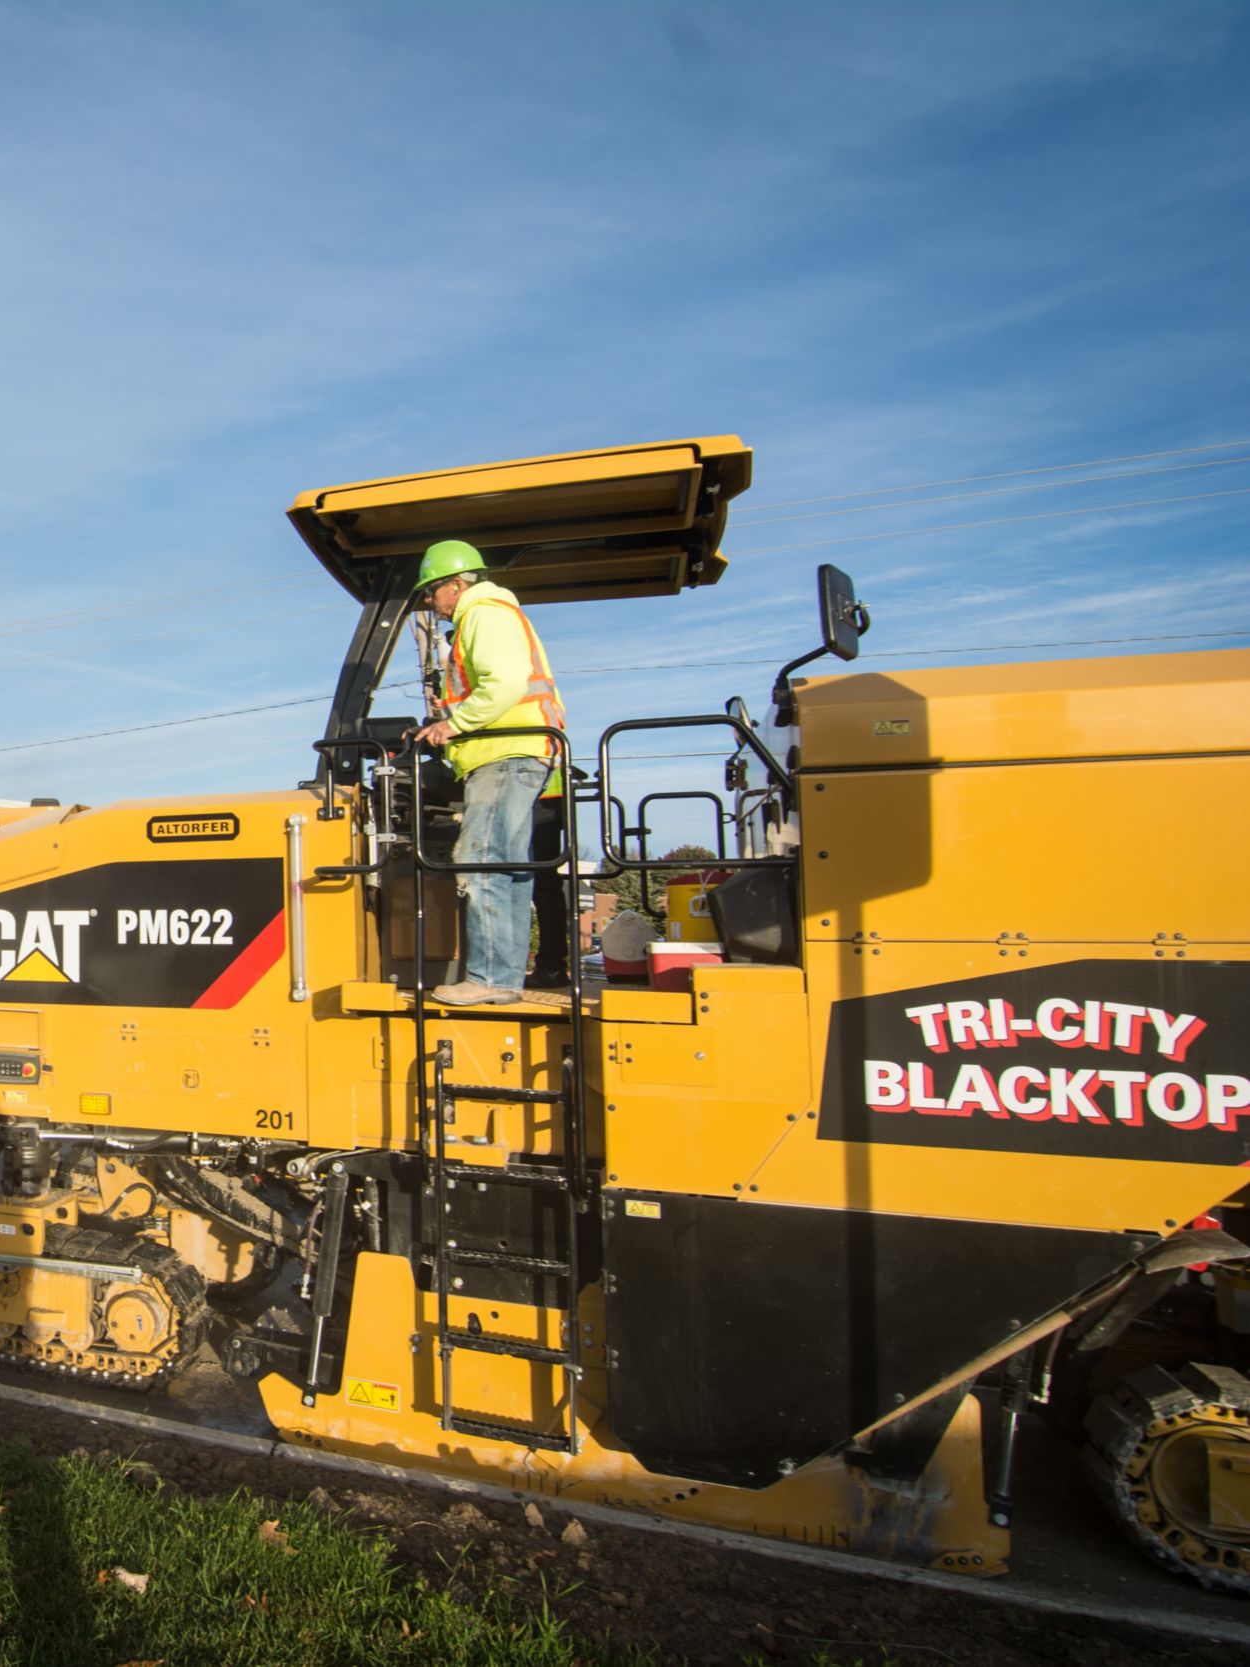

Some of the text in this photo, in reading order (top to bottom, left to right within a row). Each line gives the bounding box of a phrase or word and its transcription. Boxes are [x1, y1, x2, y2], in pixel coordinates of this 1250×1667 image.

[156, 821, 230, 836] ALTORFER
[117, 908, 234, 946] PM622
[905, 998, 1203, 1060] TRI-CITY
[864, 1059, 1250, 1130] BLACKTOP
[256, 1109, 293, 1130] 201
